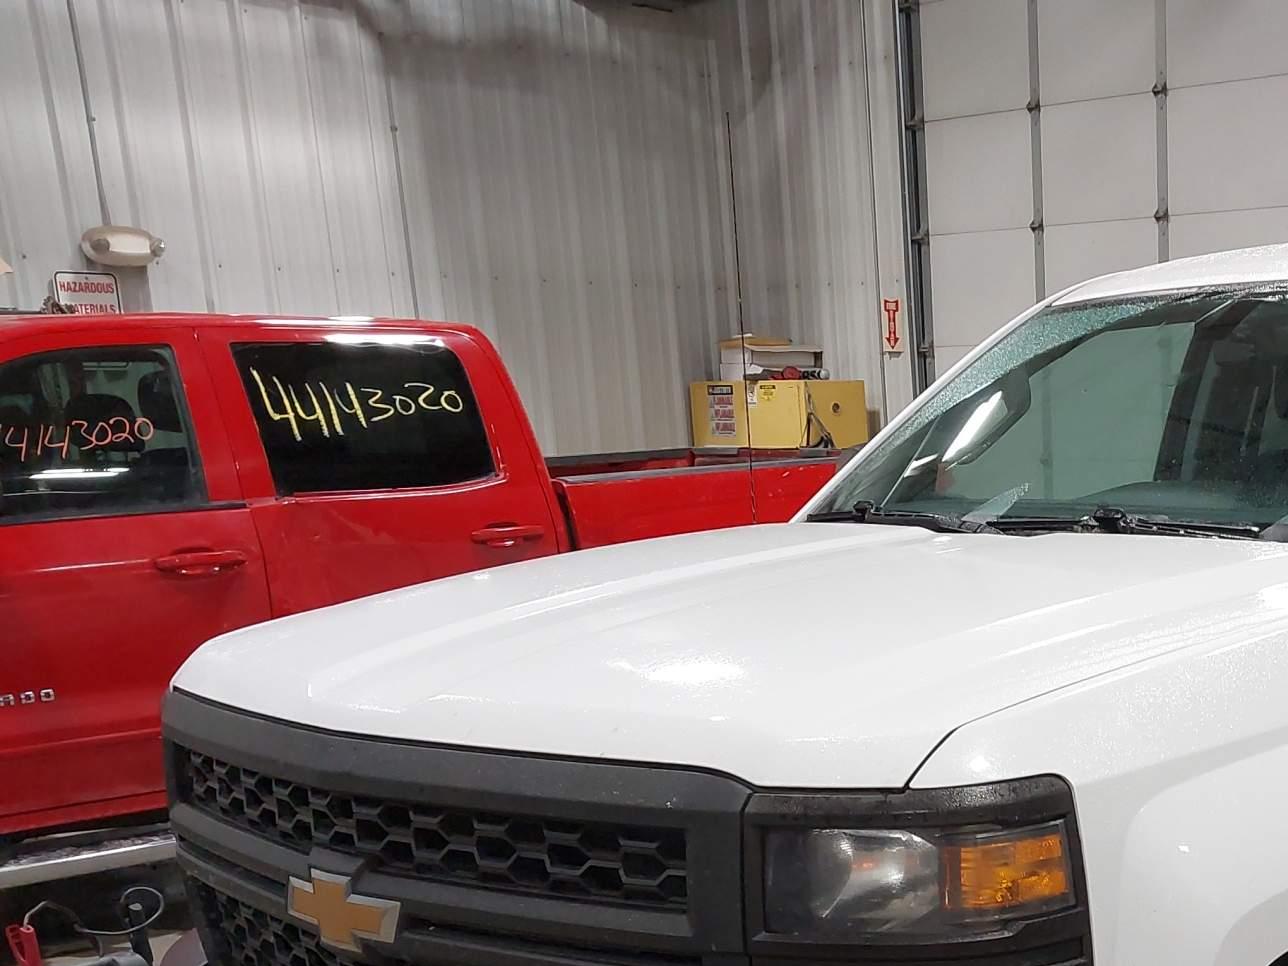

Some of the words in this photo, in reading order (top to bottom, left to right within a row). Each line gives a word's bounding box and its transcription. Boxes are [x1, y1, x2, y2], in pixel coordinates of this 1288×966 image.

[58, 281, 115, 294] HAZARDOUS
[69, 303, 117, 314] ATERIALS
[250, 366, 464, 441] 44143020
[0, 416, 154, 463] 4143020
